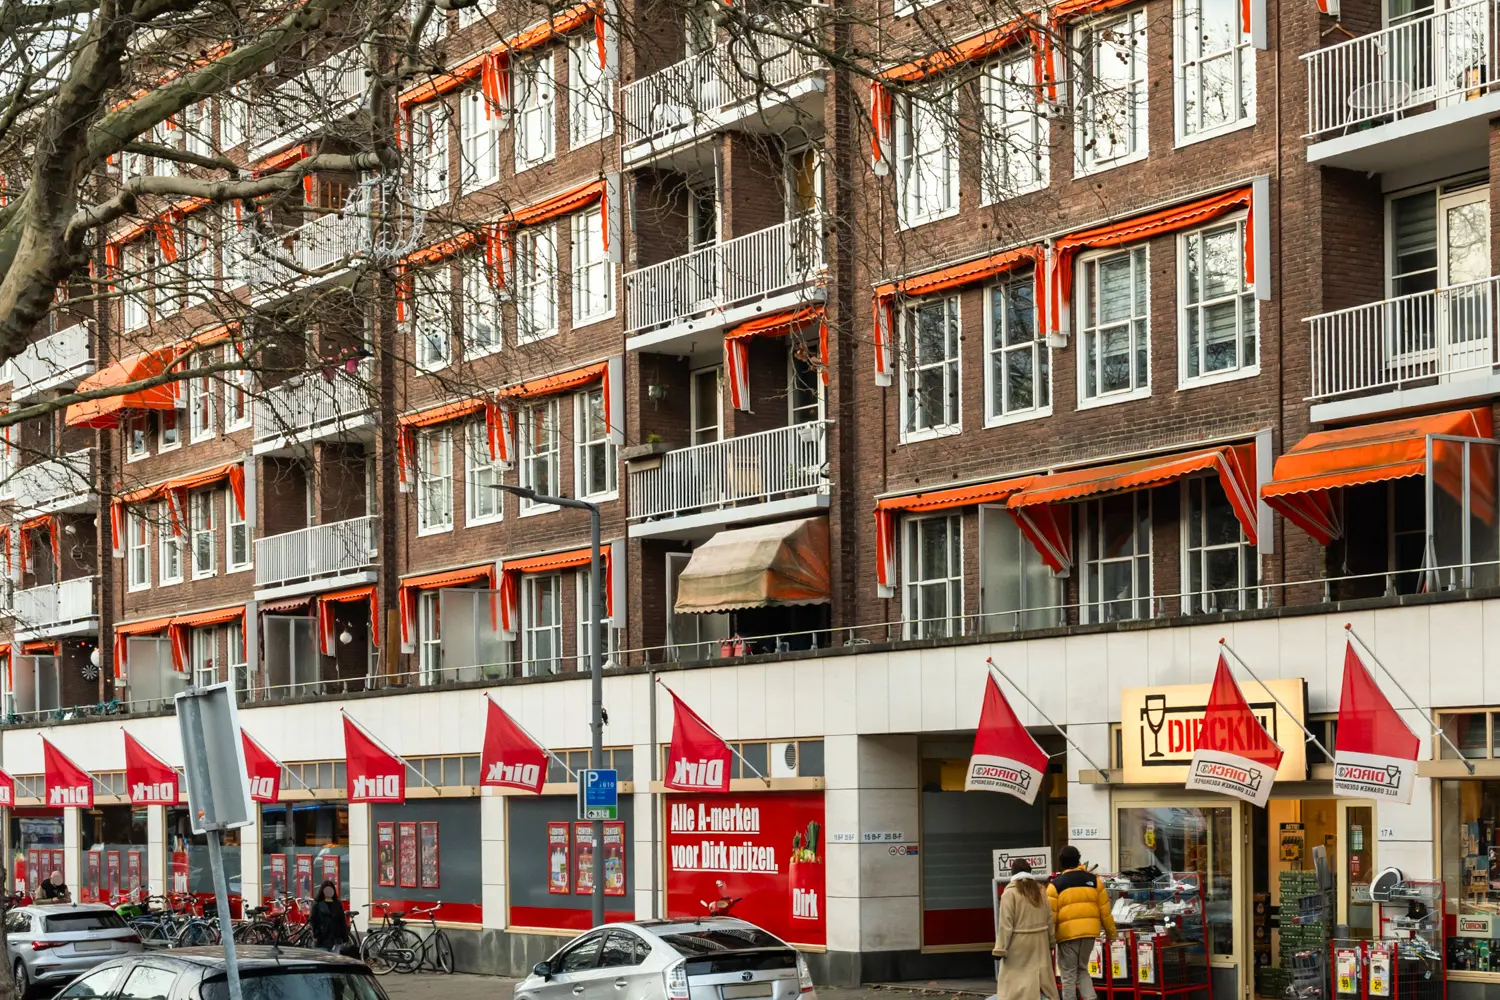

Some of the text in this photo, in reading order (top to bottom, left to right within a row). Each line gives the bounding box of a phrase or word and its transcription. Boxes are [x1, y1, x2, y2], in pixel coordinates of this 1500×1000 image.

[587, 771, 599, 788] P
[670, 802, 760, 832] Alle A-merken
[864, 832, 902, 841] 15 B-F 25 B-F
[1381, 829, 1388, 837] 17
[671, 840, 779, 872] voor Dirk prijzen.
[792, 887, 818, 918] Dirk
